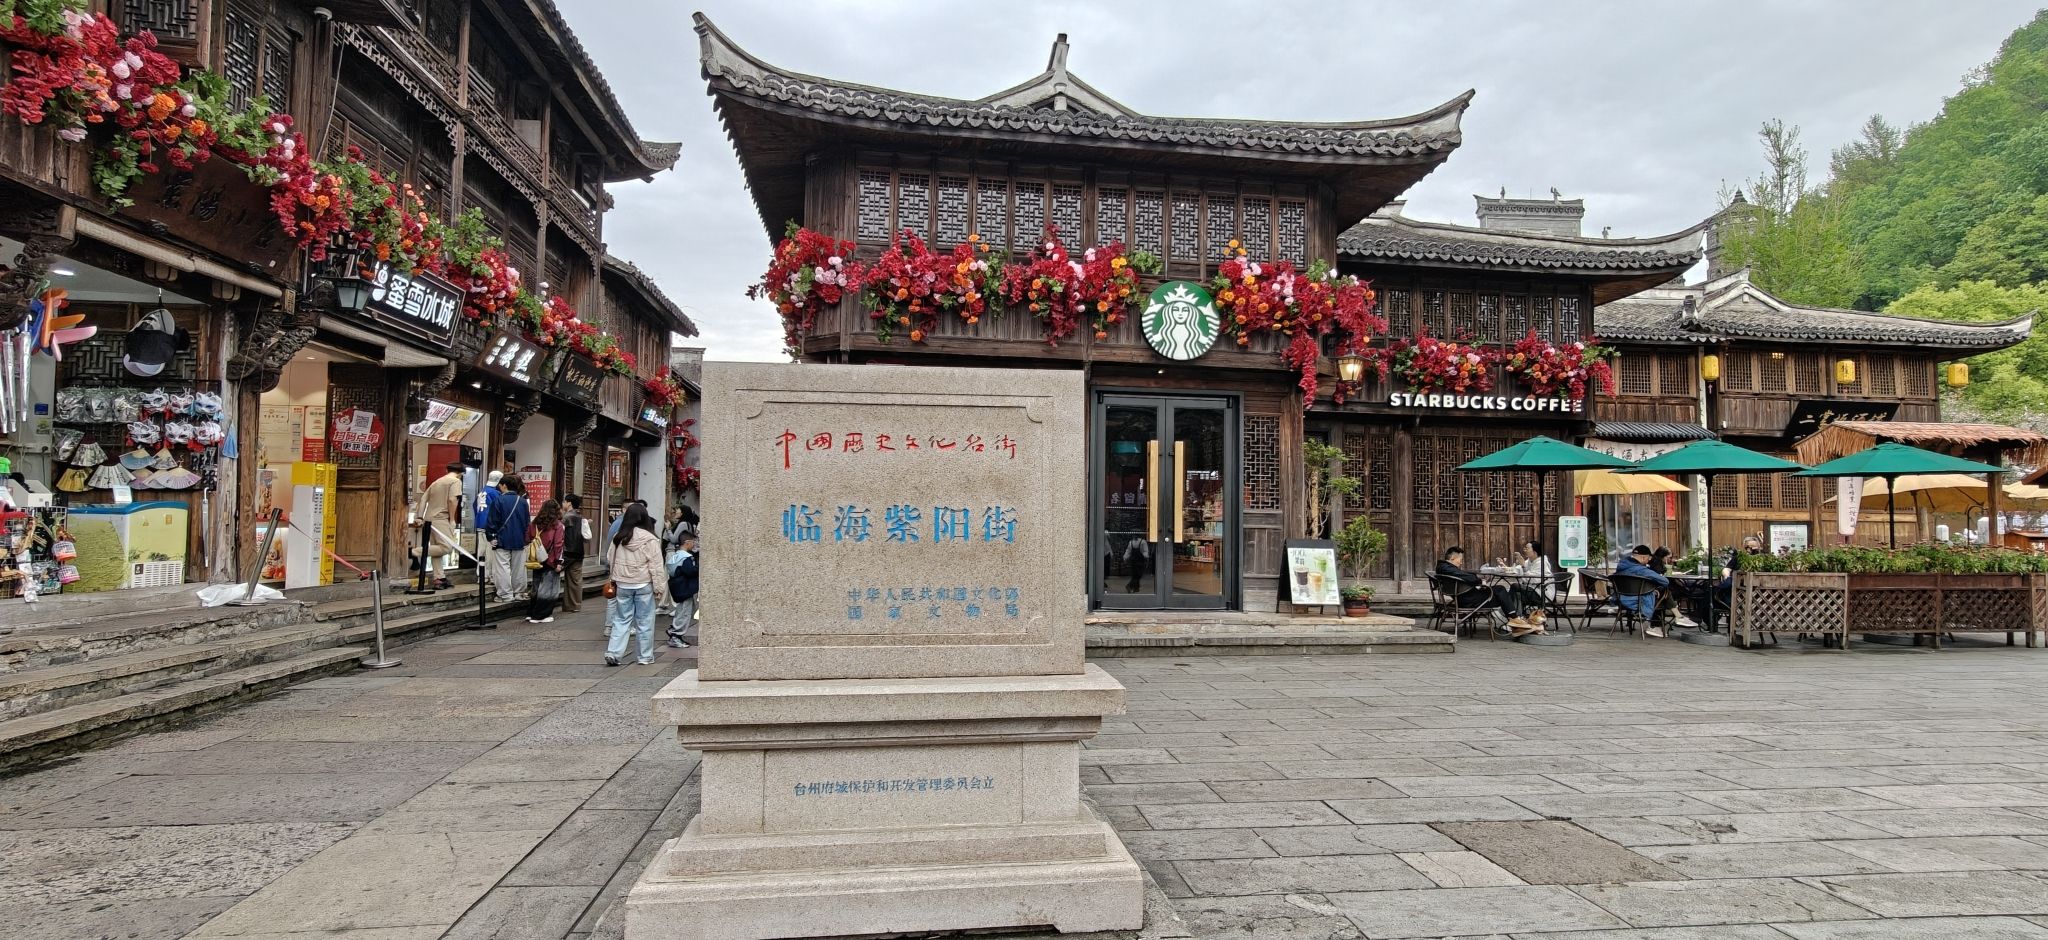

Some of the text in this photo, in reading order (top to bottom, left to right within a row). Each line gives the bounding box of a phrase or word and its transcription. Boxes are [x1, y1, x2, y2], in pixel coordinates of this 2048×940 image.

[385, 274, 456, 330] 蜜雪冰城
[1390, 392, 1507, 410] STARBUCKS
[332, 431, 380, 443] 扫码点单
[782, 503, 1018, 544] 临海紫阳街
[793, 776, 995, 797] 台州府城保护和开发管理委员会立
